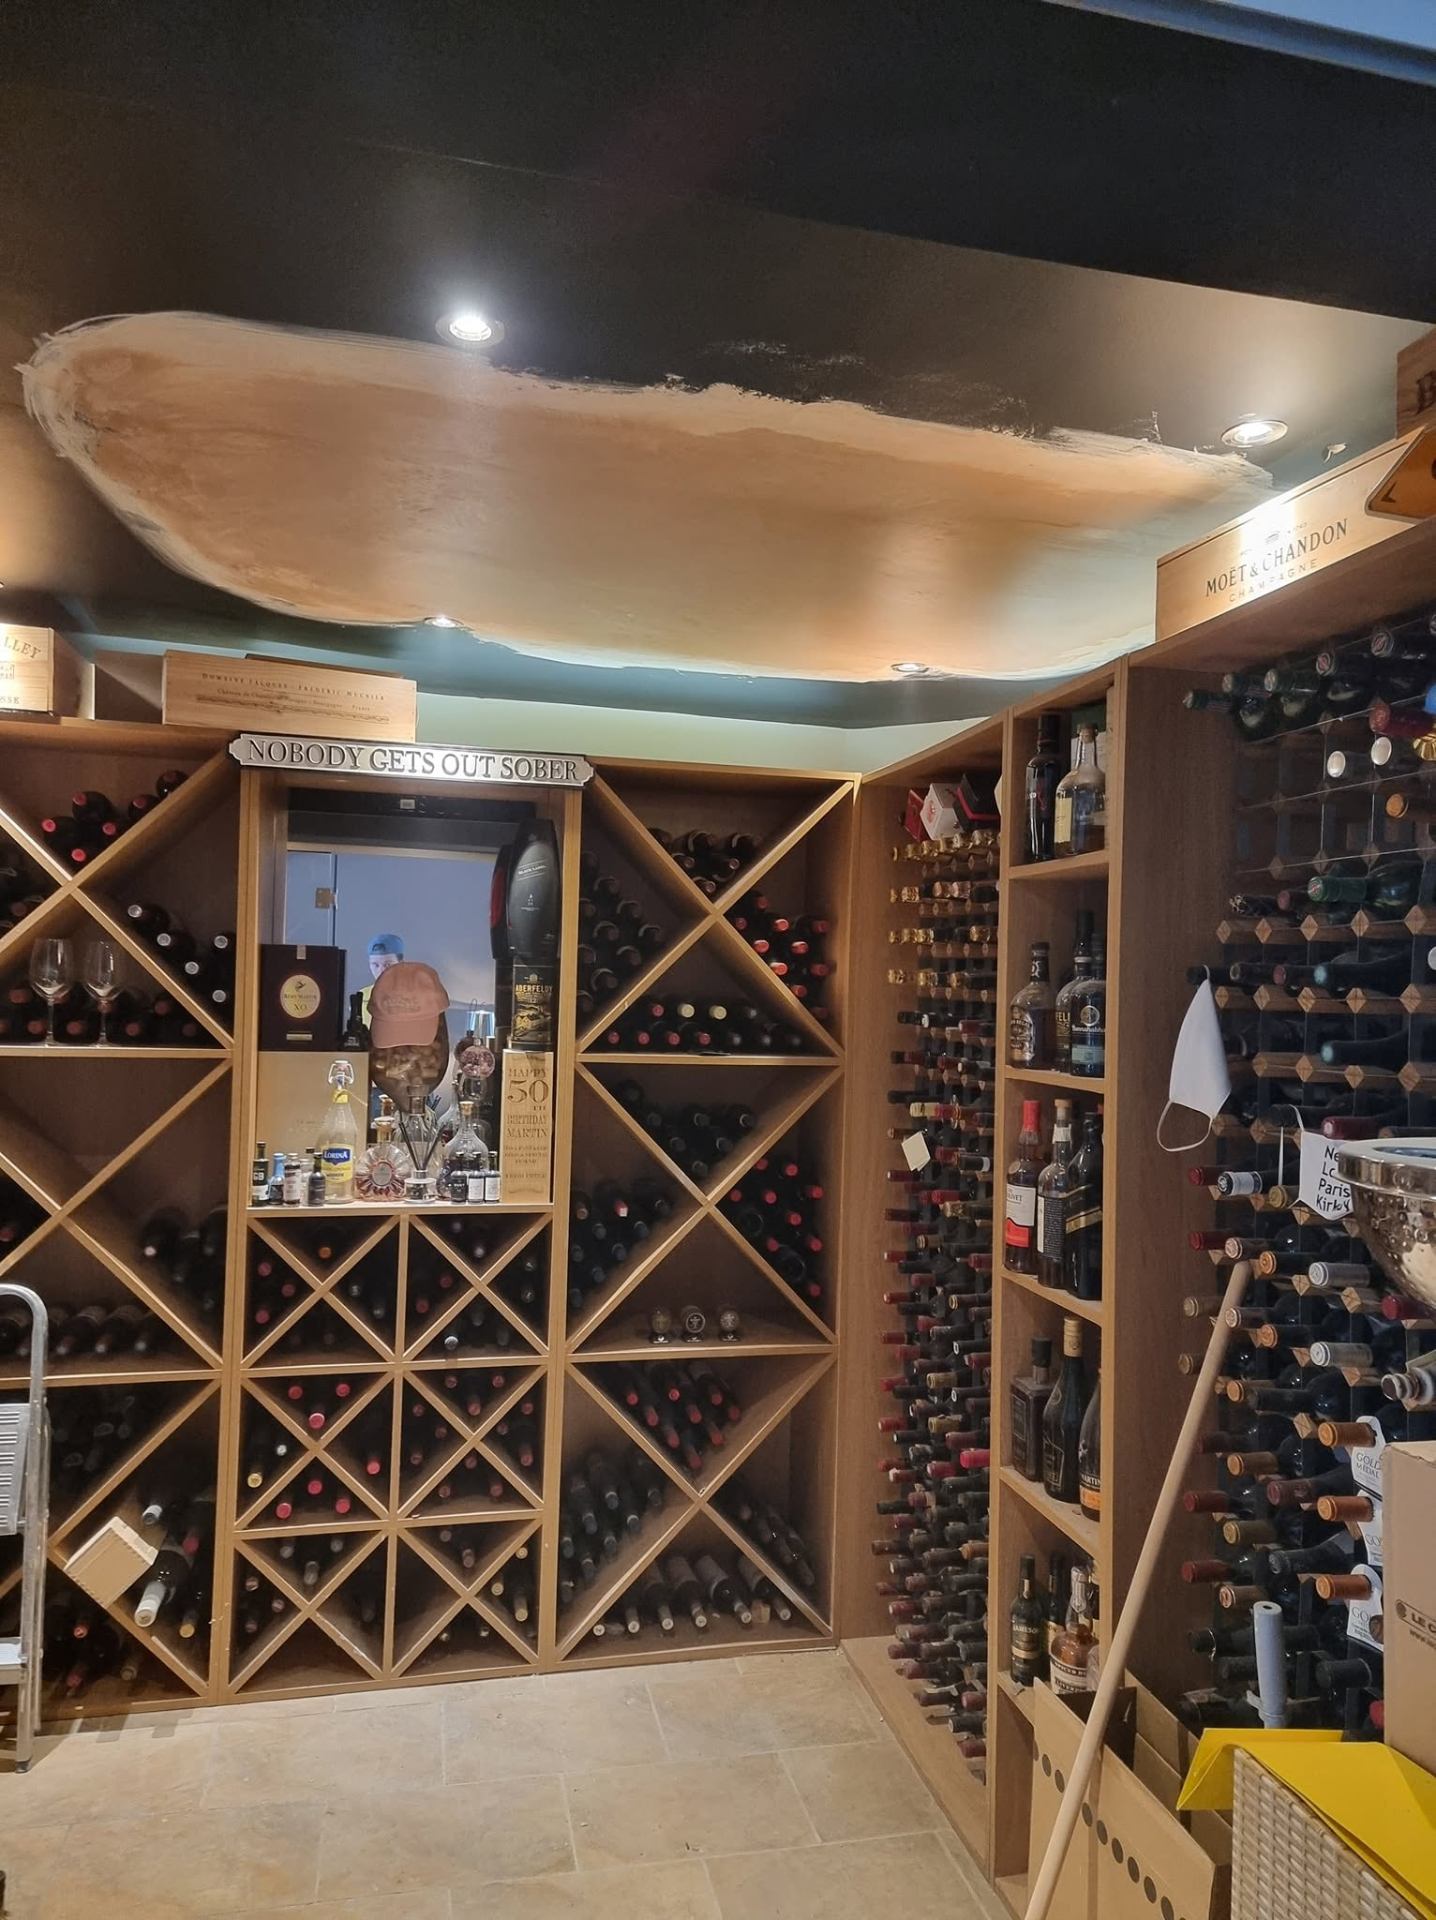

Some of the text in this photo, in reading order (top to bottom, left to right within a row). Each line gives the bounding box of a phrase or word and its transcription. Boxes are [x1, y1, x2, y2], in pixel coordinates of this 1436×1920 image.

[1205, 563, 1247, 597] MOËT
[1249, 562, 1259, 578] &
[1262, 518, 1348, 572] CHANDON
[249, 738, 577, 781] NOBODY GETS OUT SOBER
[507, 1079, 550, 1104] 50
[506, 1127, 548, 1139] MARTIN
[1318, 1178, 1351, 1198] Paris
